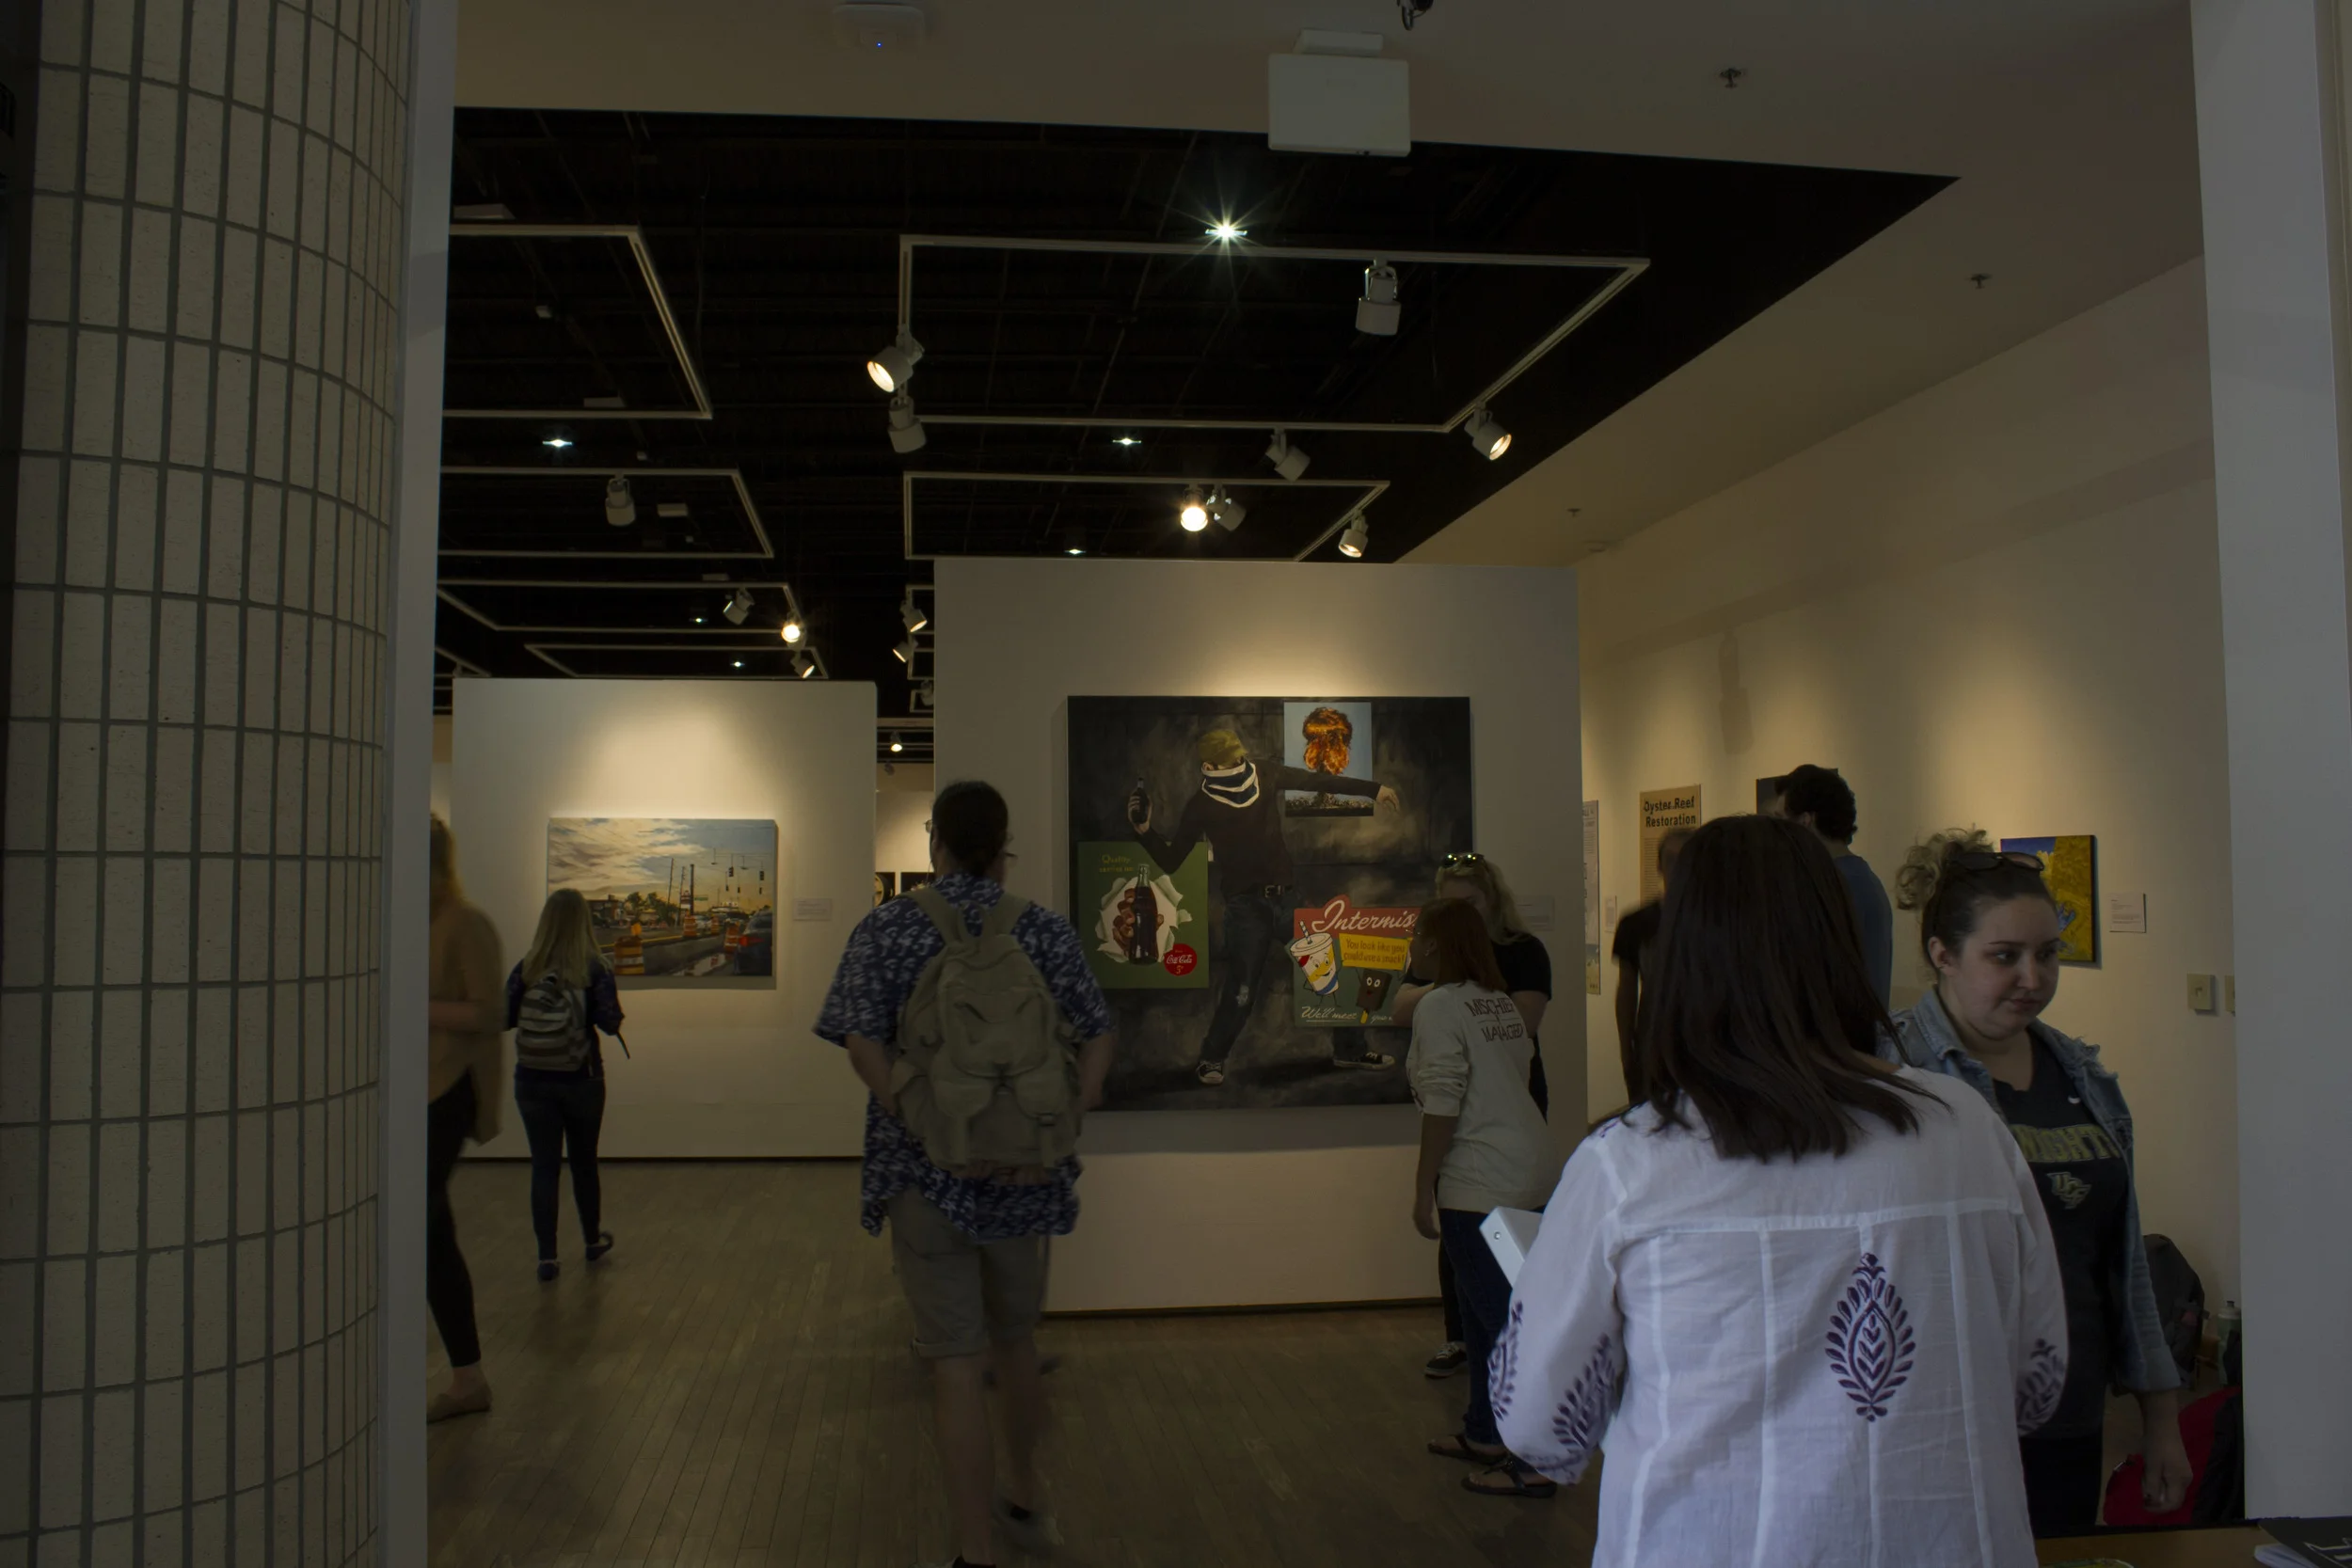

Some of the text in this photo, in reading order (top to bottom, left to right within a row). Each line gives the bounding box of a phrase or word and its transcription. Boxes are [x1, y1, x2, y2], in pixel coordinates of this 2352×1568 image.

[1644, 795, 1694, 815] Oyster Reef
[1645, 814, 1696, 828] Restoration
[1311, 899, 1419, 932] Intermis
[1345, 937, 1359, 949] You
[1360, 939, 1376, 951] look
[1391, 943, 1406, 954] you
[1481, 1023, 1524, 1043] MANAGED
[2010, 1123, 2121, 1164] NIGHT
[2046, 1171, 2092, 1210] UCF
